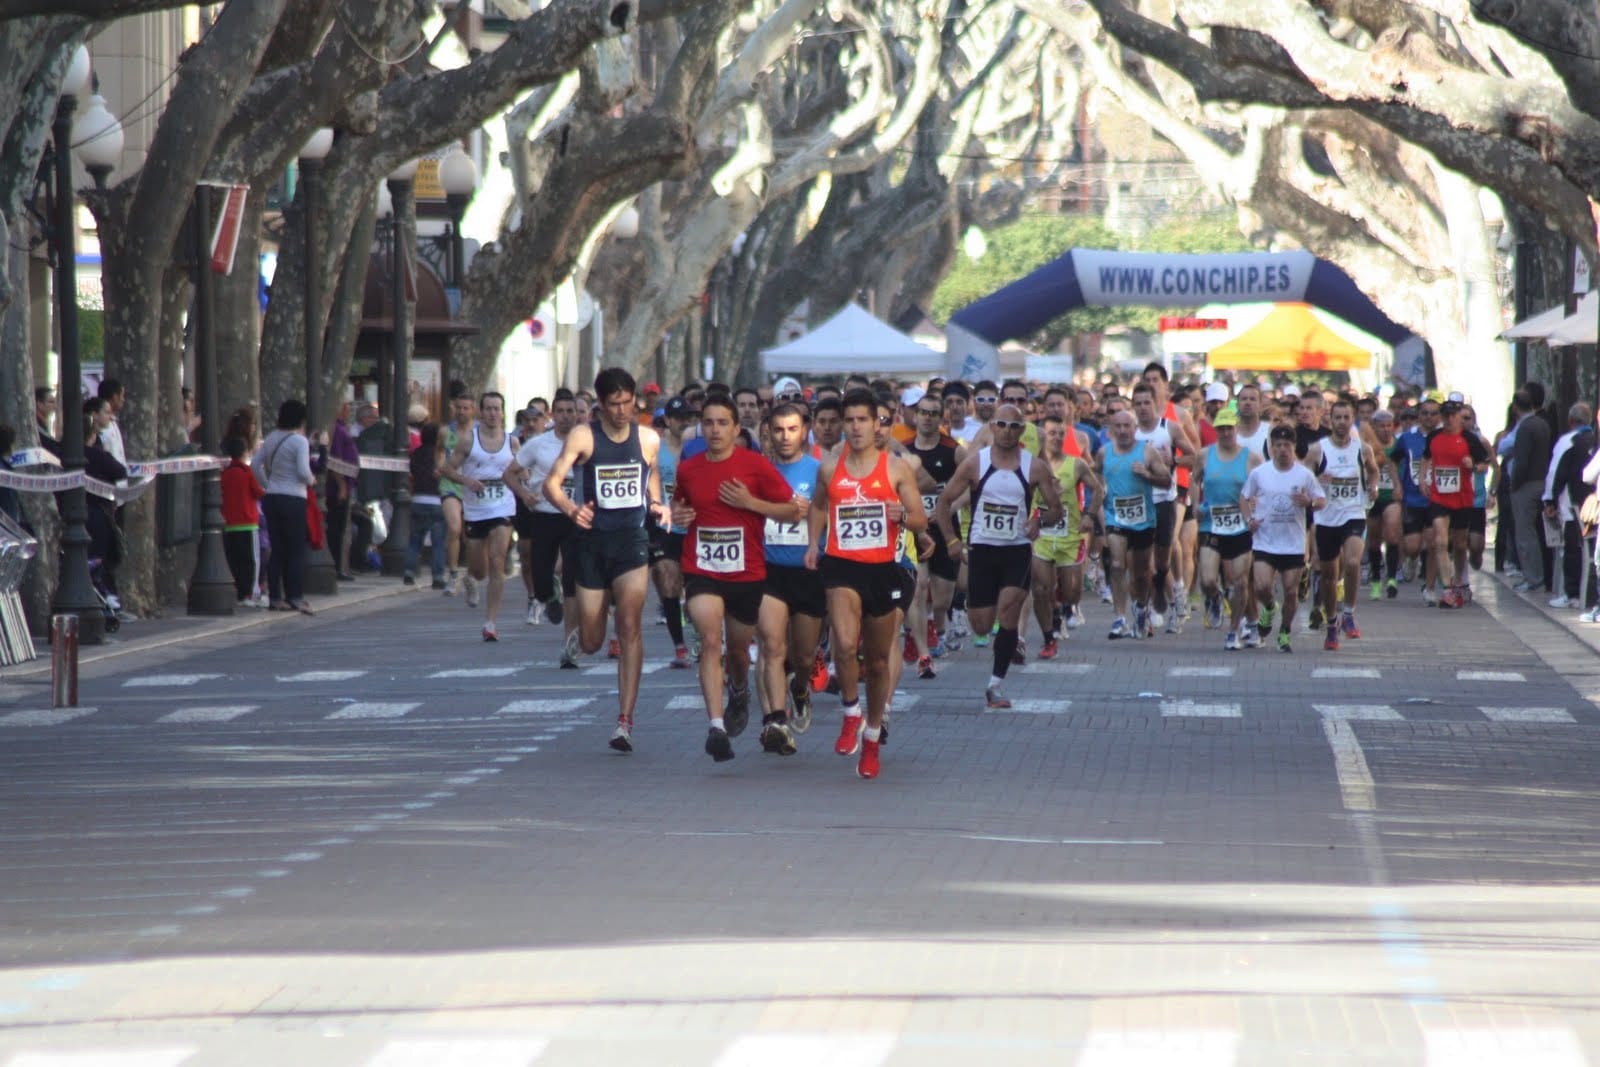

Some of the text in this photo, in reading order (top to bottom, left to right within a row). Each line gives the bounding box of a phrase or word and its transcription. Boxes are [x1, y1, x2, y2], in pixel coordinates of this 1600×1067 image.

[1098, 264, 1291, 295] WWW.CONCHIP.ES
[600, 480, 638, 498] 666
[1331, 486, 1358, 498] 365
[1116, 506, 1144, 519] 353
[840, 520, 883, 540] 239
[984, 514, 1015, 531] 161
[1214, 515, 1240, 528] 354
[700, 543, 740, 562] 340
